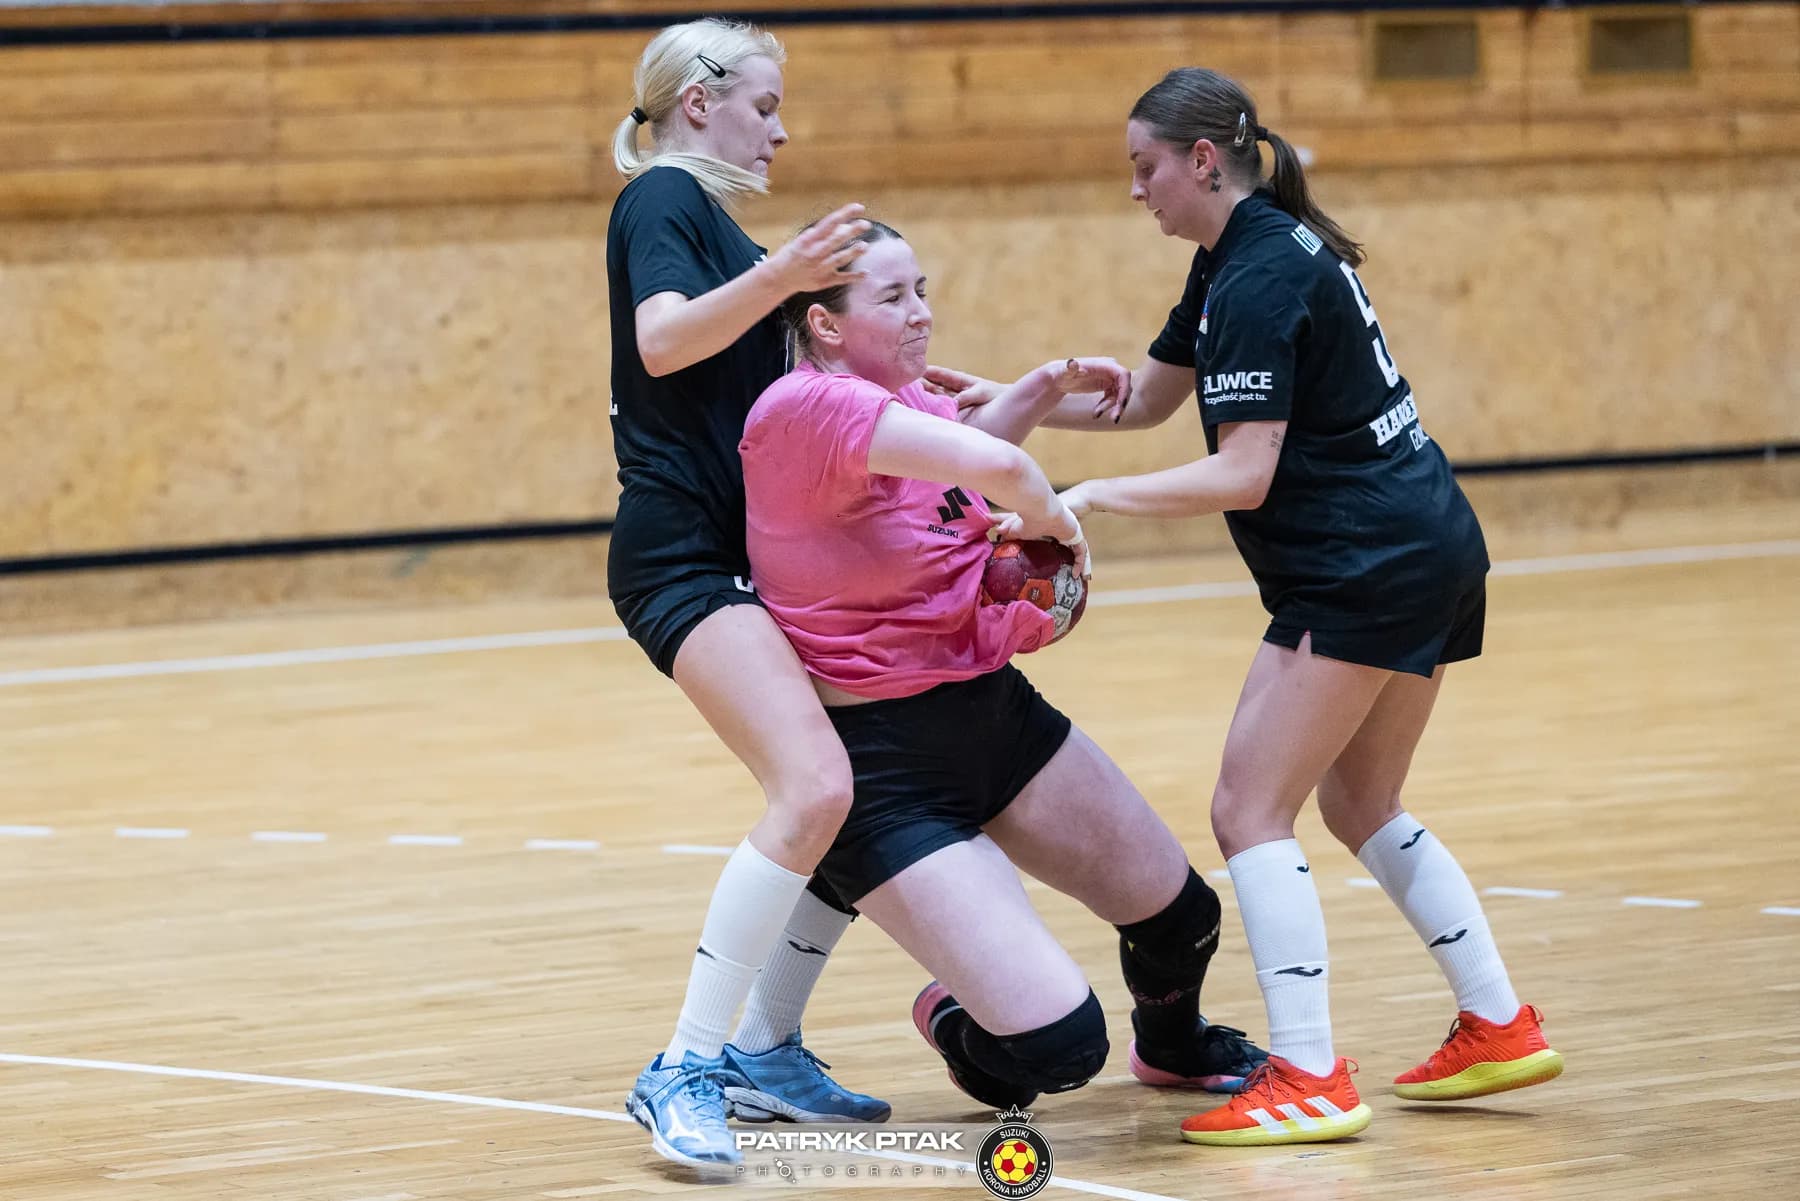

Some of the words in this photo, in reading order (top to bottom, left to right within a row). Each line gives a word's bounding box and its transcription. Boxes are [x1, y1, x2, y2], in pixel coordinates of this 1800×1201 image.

[1204, 392, 1239, 405] rzyszłość
[1238, 392, 1255, 402] jest
[1255, 392, 1268, 401] tu.
[927, 523, 959, 539] SUZUKI
